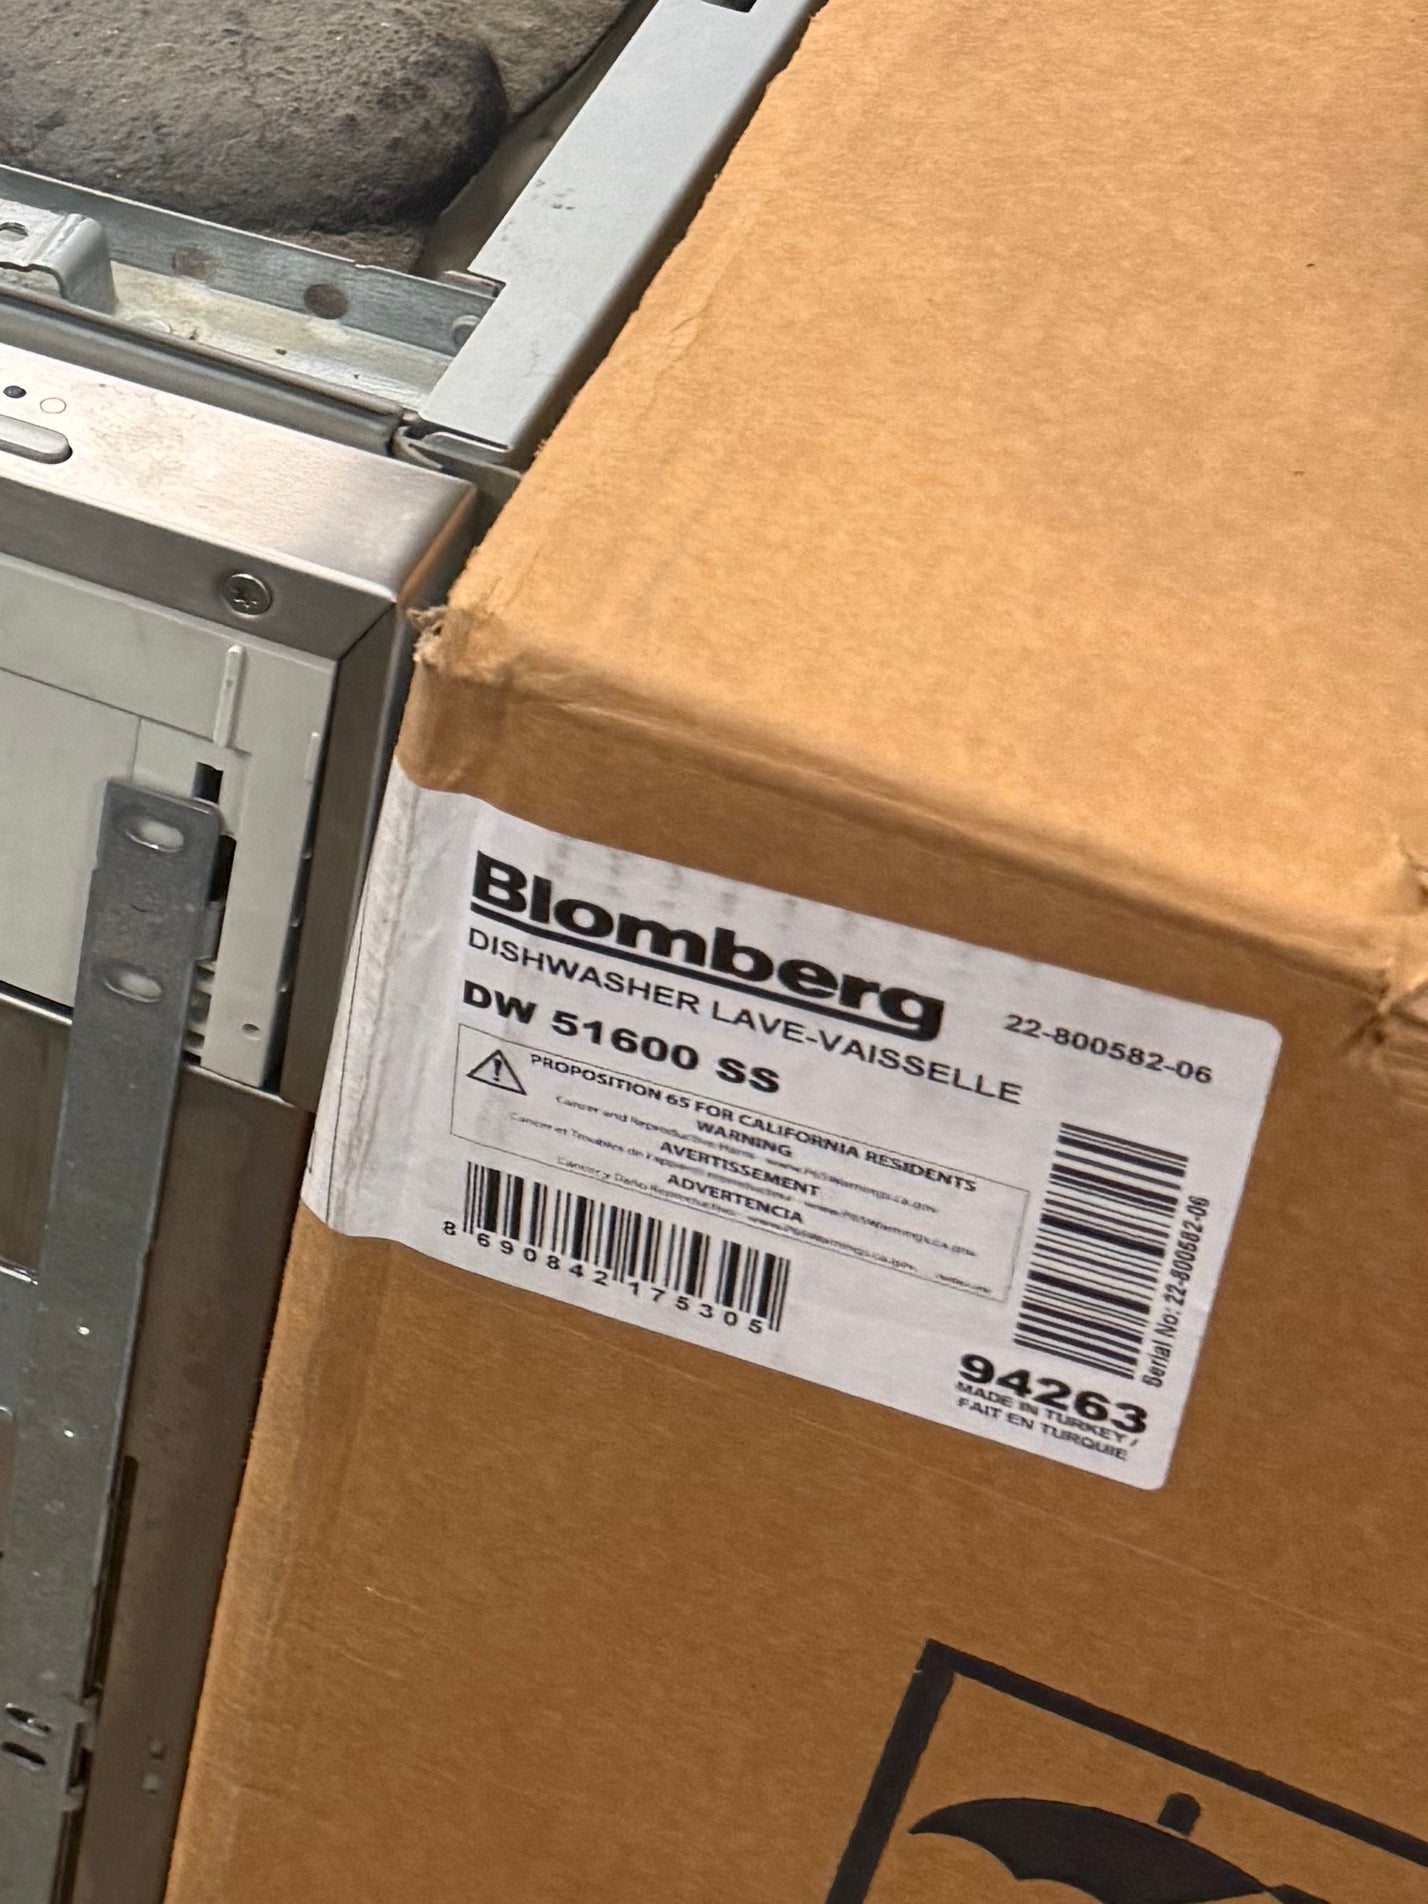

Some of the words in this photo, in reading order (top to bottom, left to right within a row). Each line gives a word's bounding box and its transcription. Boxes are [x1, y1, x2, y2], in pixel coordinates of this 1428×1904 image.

[473, 851, 944, 1041] Blomberg
[464, 980, 537, 1024] DW
[552, 1011, 698, 1070] 51600
[716, 1058, 779, 1093] SS
[469, 928, 699, 1014] DISHWASHER
[712, 1001, 1022, 1104] LAVE-VAISSELLE
[1004, 1014, 1212, 1083] 22-800582-06
[531, 1054, 661, 1100] PROPOSITION
[666, 1095, 690, 1108] 65
[695, 1101, 733, 1121] FOR
[739, 1115, 859, 1158] CALIFORNIA
[865, 1151, 976, 1191] RESIDENTS
[697, 1121, 792, 1157] WARNING
[660, 1142, 820, 1195] AVERTISSEMENT
[668, 1175, 802, 1223] ADVERTENCIA
[1165, 1194, 1211, 1308] 22-800582-06
[1155, 1305, 1183, 1341] No:
[956, 1381, 1012, 1408] MADE
[1019, 1402, 1038, 1416] IN
[1046, 1408, 1126, 1442] TURKEY
[960, 1354, 1147, 1433] 94263
[958, 1397, 1002, 1418] FAIT
[1007, 1413, 1034, 1429] EN
[1041, 1423, 1127, 1460] TURQUIE
